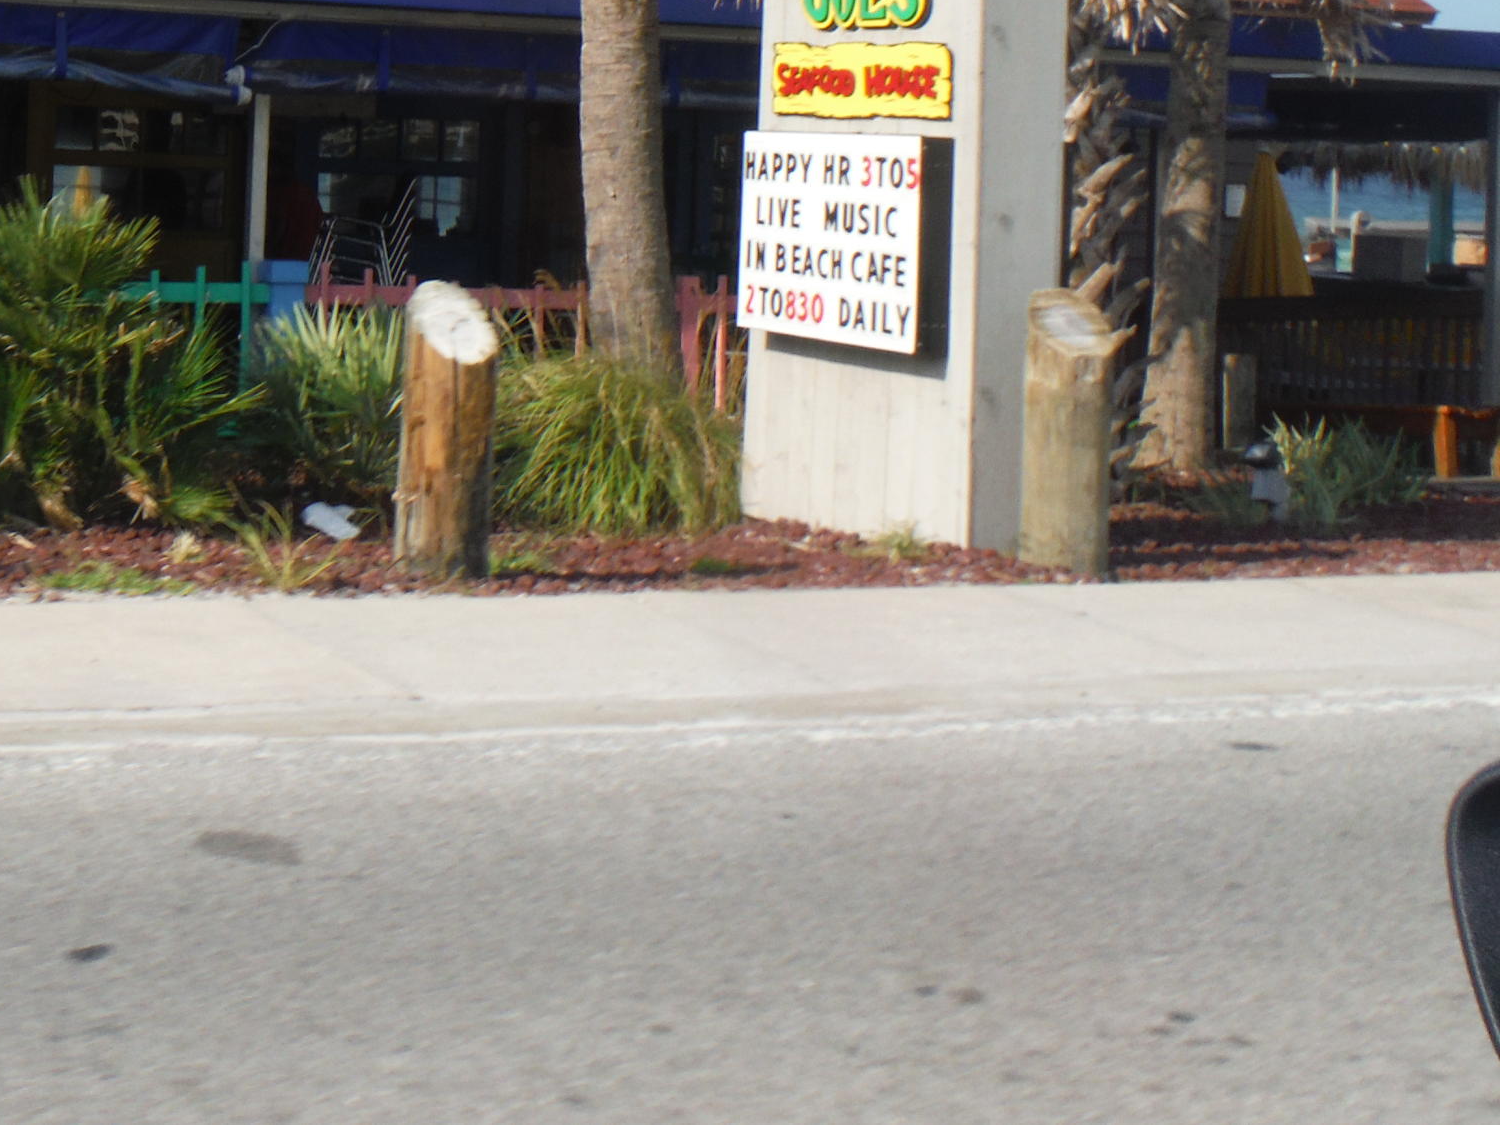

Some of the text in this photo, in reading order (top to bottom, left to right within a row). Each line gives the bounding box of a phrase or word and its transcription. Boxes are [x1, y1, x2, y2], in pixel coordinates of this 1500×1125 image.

[864, 64, 941, 99] HOUSE
[745, 151, 812, 183] HAPPY
[823, 154, 850, 186] HR
[756, 196, 898, 238] LIVE MUSIC
[746, 239, 907, 287] IN BEACH CAFE
[839, 297, 911, 337] DAILY
